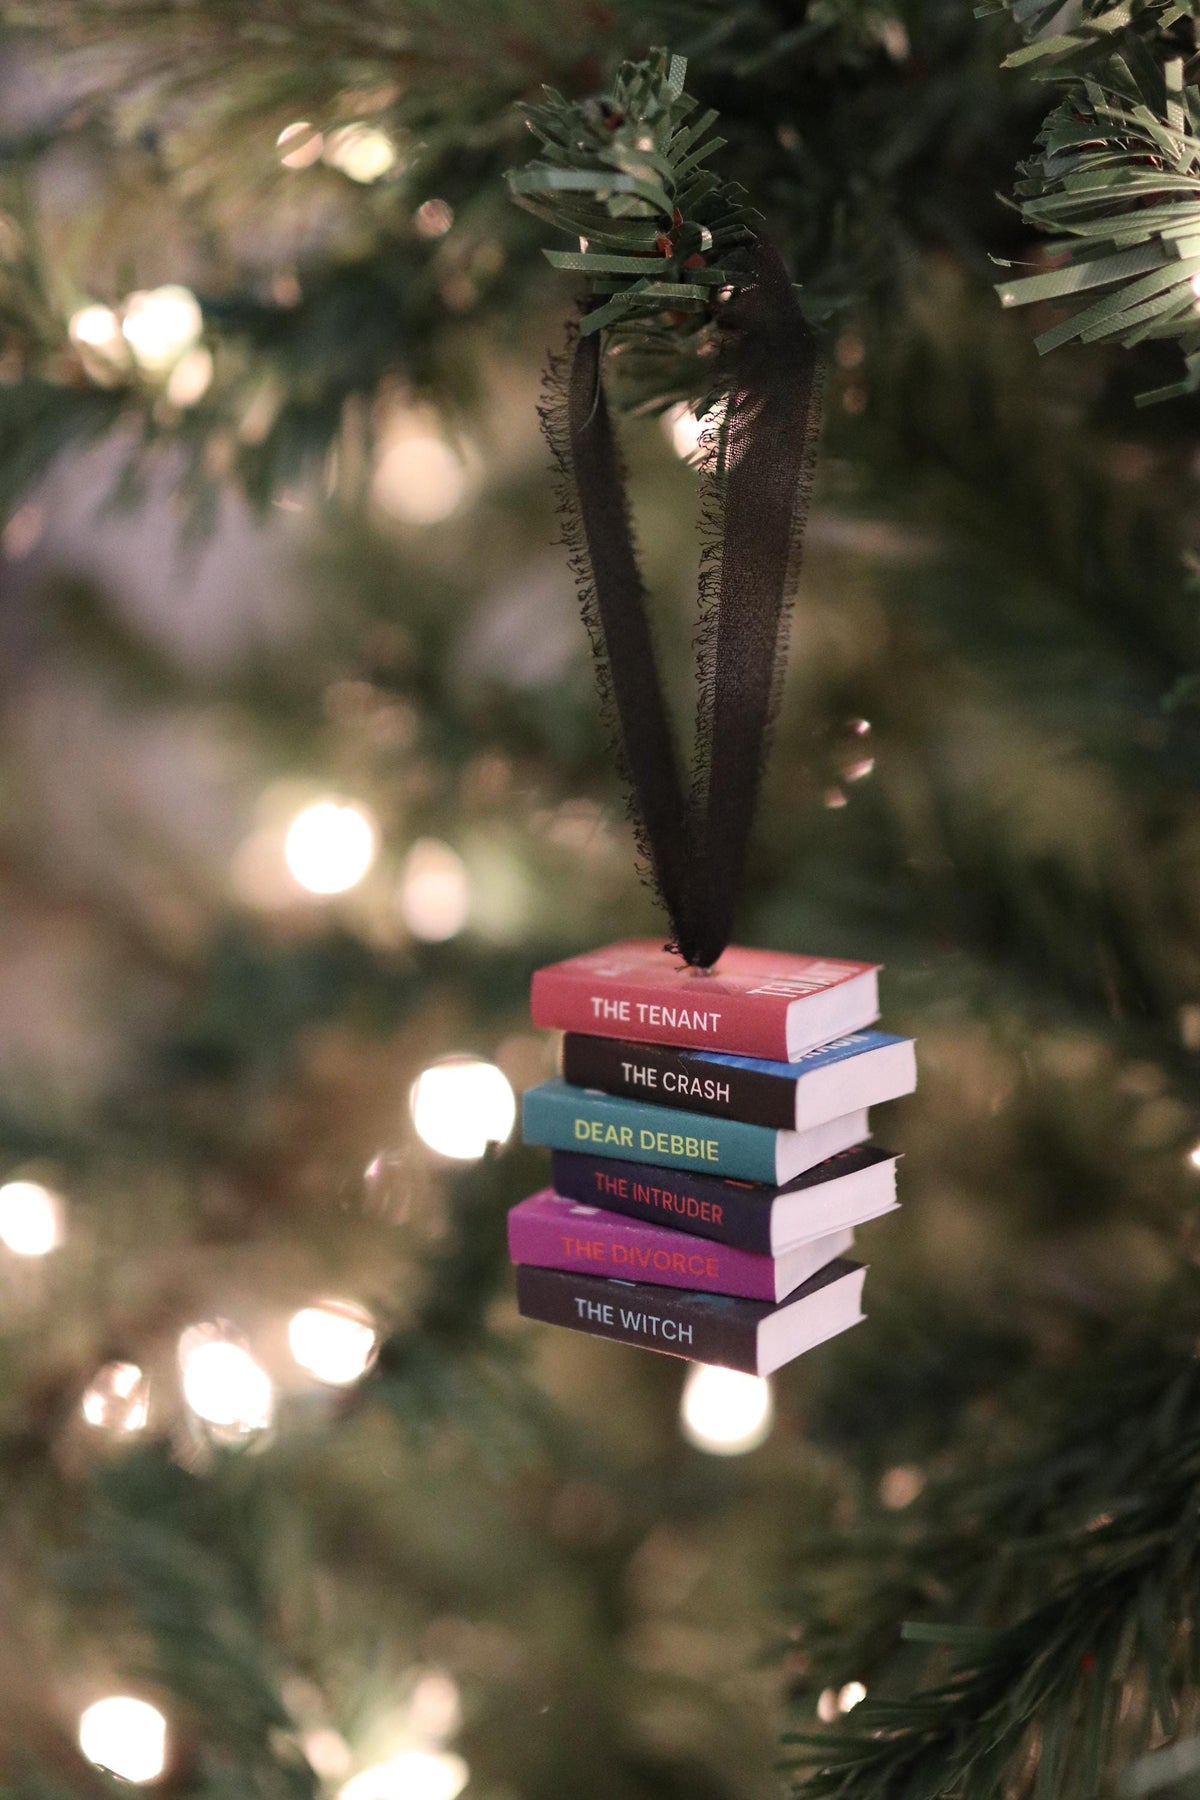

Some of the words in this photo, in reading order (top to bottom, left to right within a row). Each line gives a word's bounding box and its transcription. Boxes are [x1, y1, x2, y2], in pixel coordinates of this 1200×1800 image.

[590, 997, 630, 1021] THE
[636, 1003, 721, 1032] TENANT
[621, 1062, 657, 1088] THE
[663, 1072, 730, 1103] CRASH
[574, 1119, 633, 1147] DEAR
[640, 1130, 719, 1161] DEBBIE
[594, 1172, 628, 1198] THE
[633, 1183, 723, 1224] INTRUDER
[561, 1237, 605, 1261] THE
[611, 1244, 719, 1278] DIVORCE
[574, 1297, 614, 1325] THE
[620, 1309, 693, 1344] WITCH
